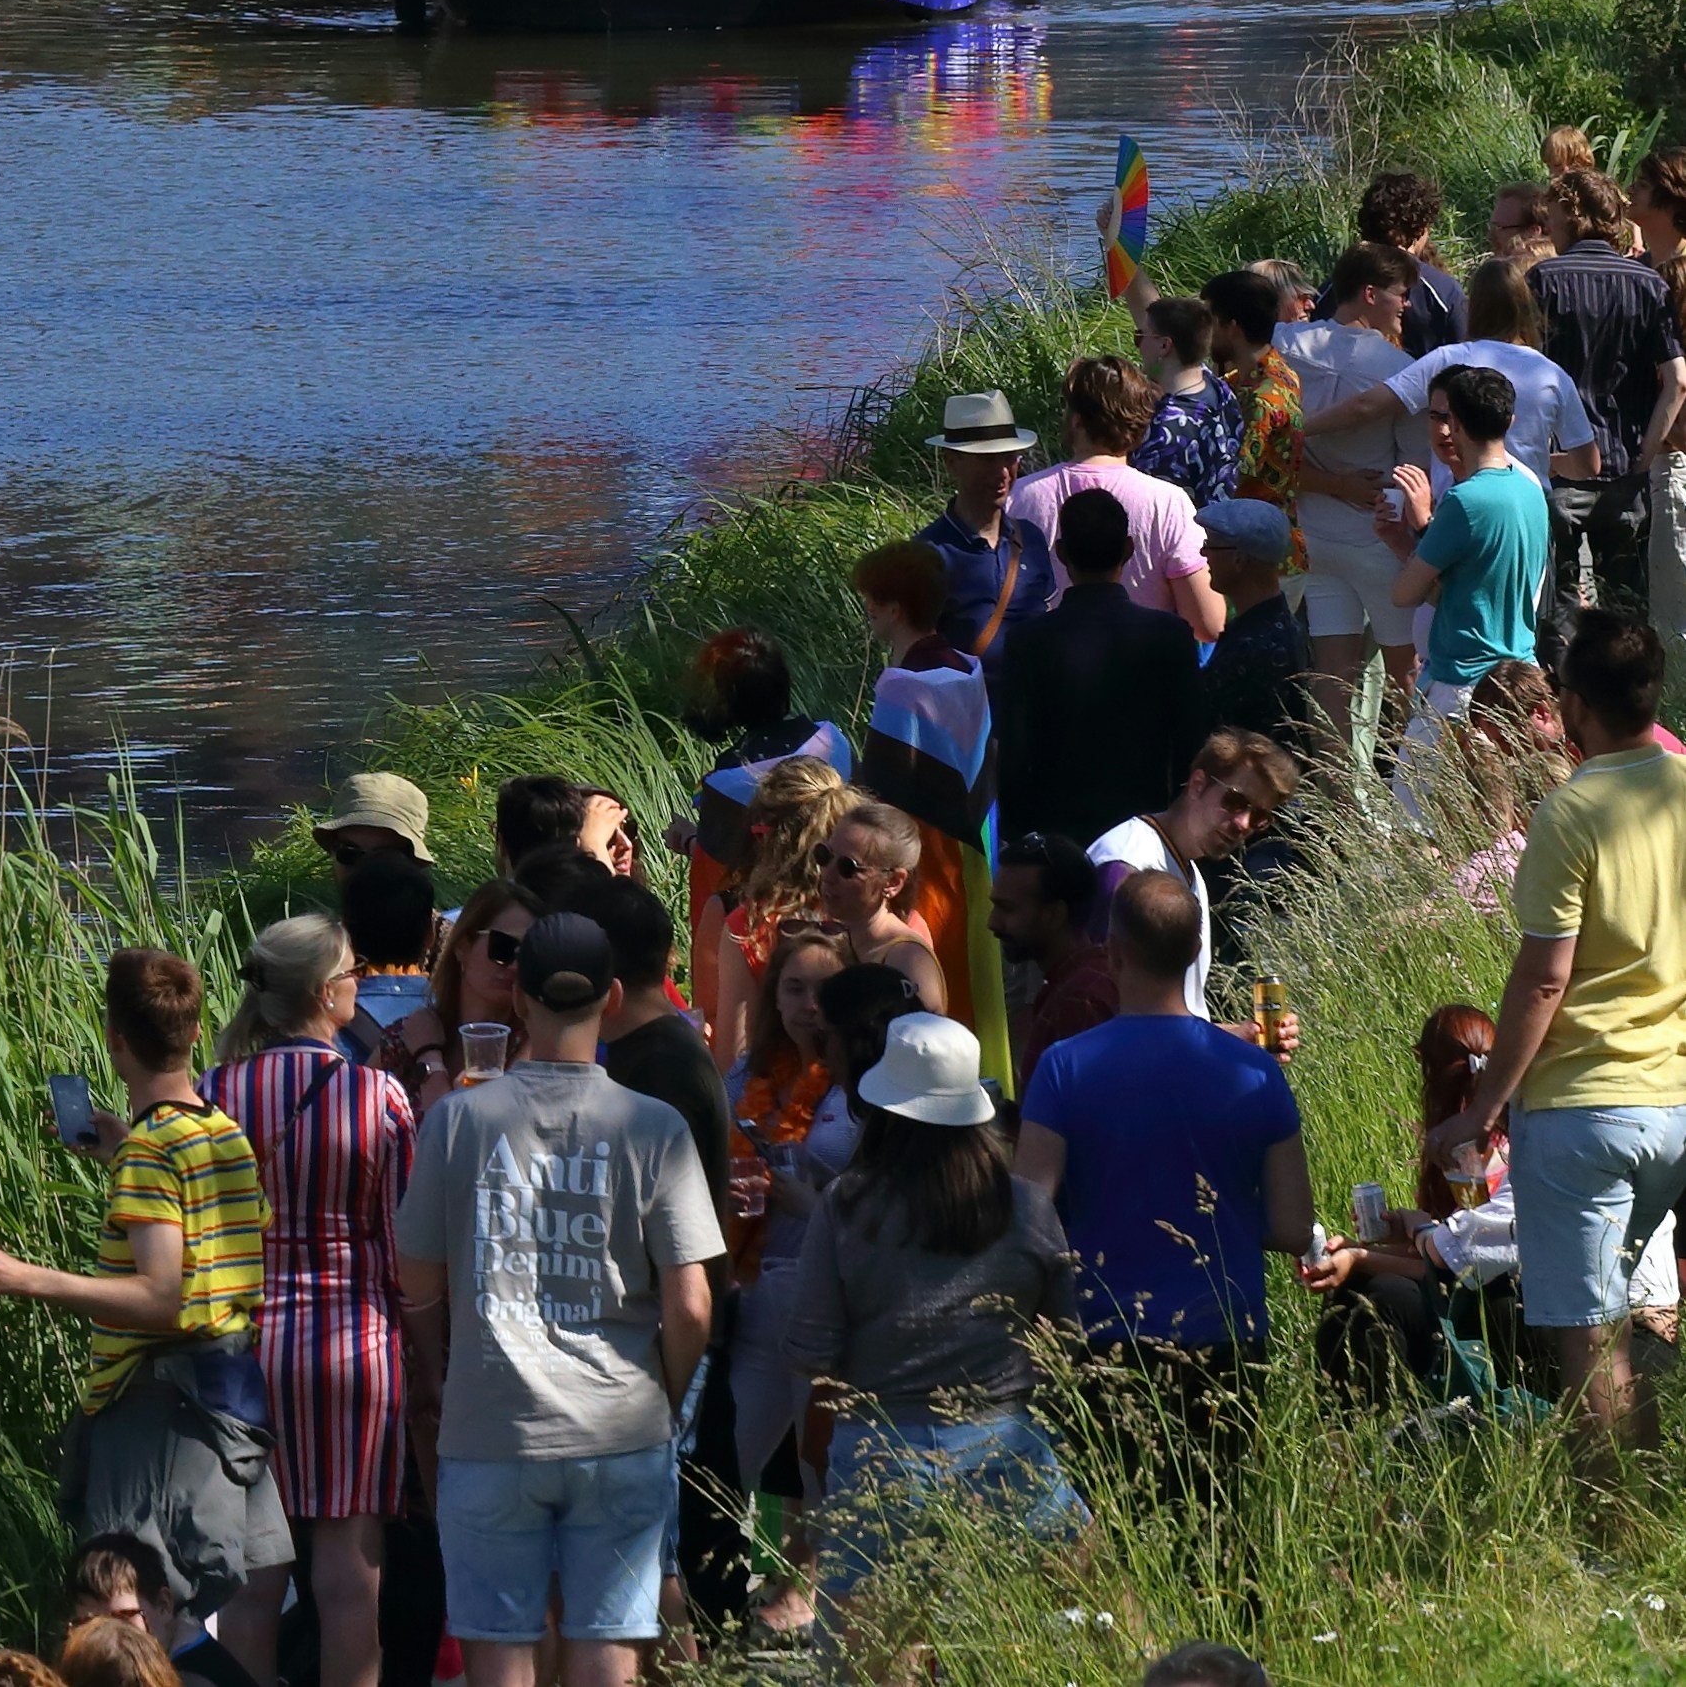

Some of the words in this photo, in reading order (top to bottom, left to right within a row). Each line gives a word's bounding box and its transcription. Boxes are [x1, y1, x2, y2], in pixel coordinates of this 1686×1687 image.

[475, 1132, 611, 1197] Anti
[473, 1184, 607, 1249] Blue
[473, 1237, 603, 1282] Denim
[475, 1291, 602, 1331] Original
[529, 1331, 544, 1343] TO
